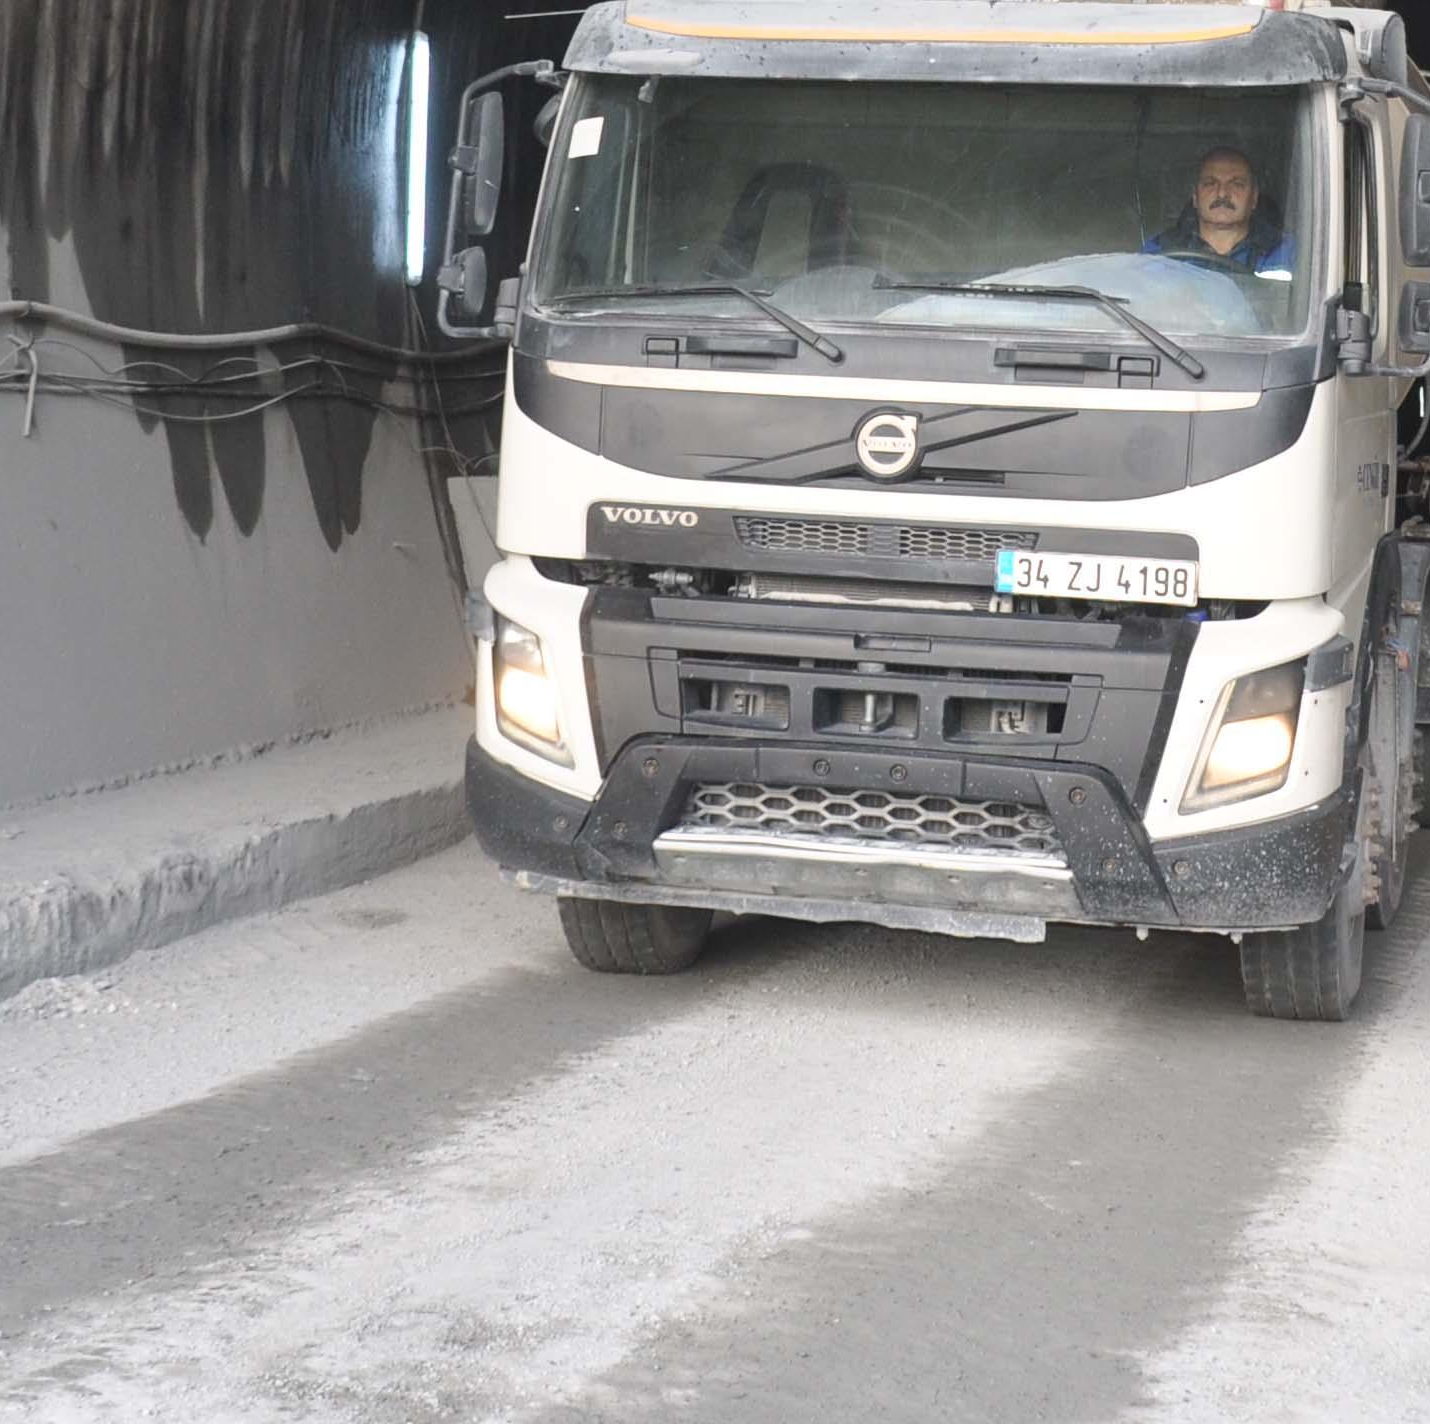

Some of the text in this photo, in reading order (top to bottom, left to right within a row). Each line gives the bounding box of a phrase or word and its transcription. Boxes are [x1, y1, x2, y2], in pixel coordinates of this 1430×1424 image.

[600, 506, 699, 527] VOLVO
[1017, 558, 1188, 598] 34 ZJ 4198
